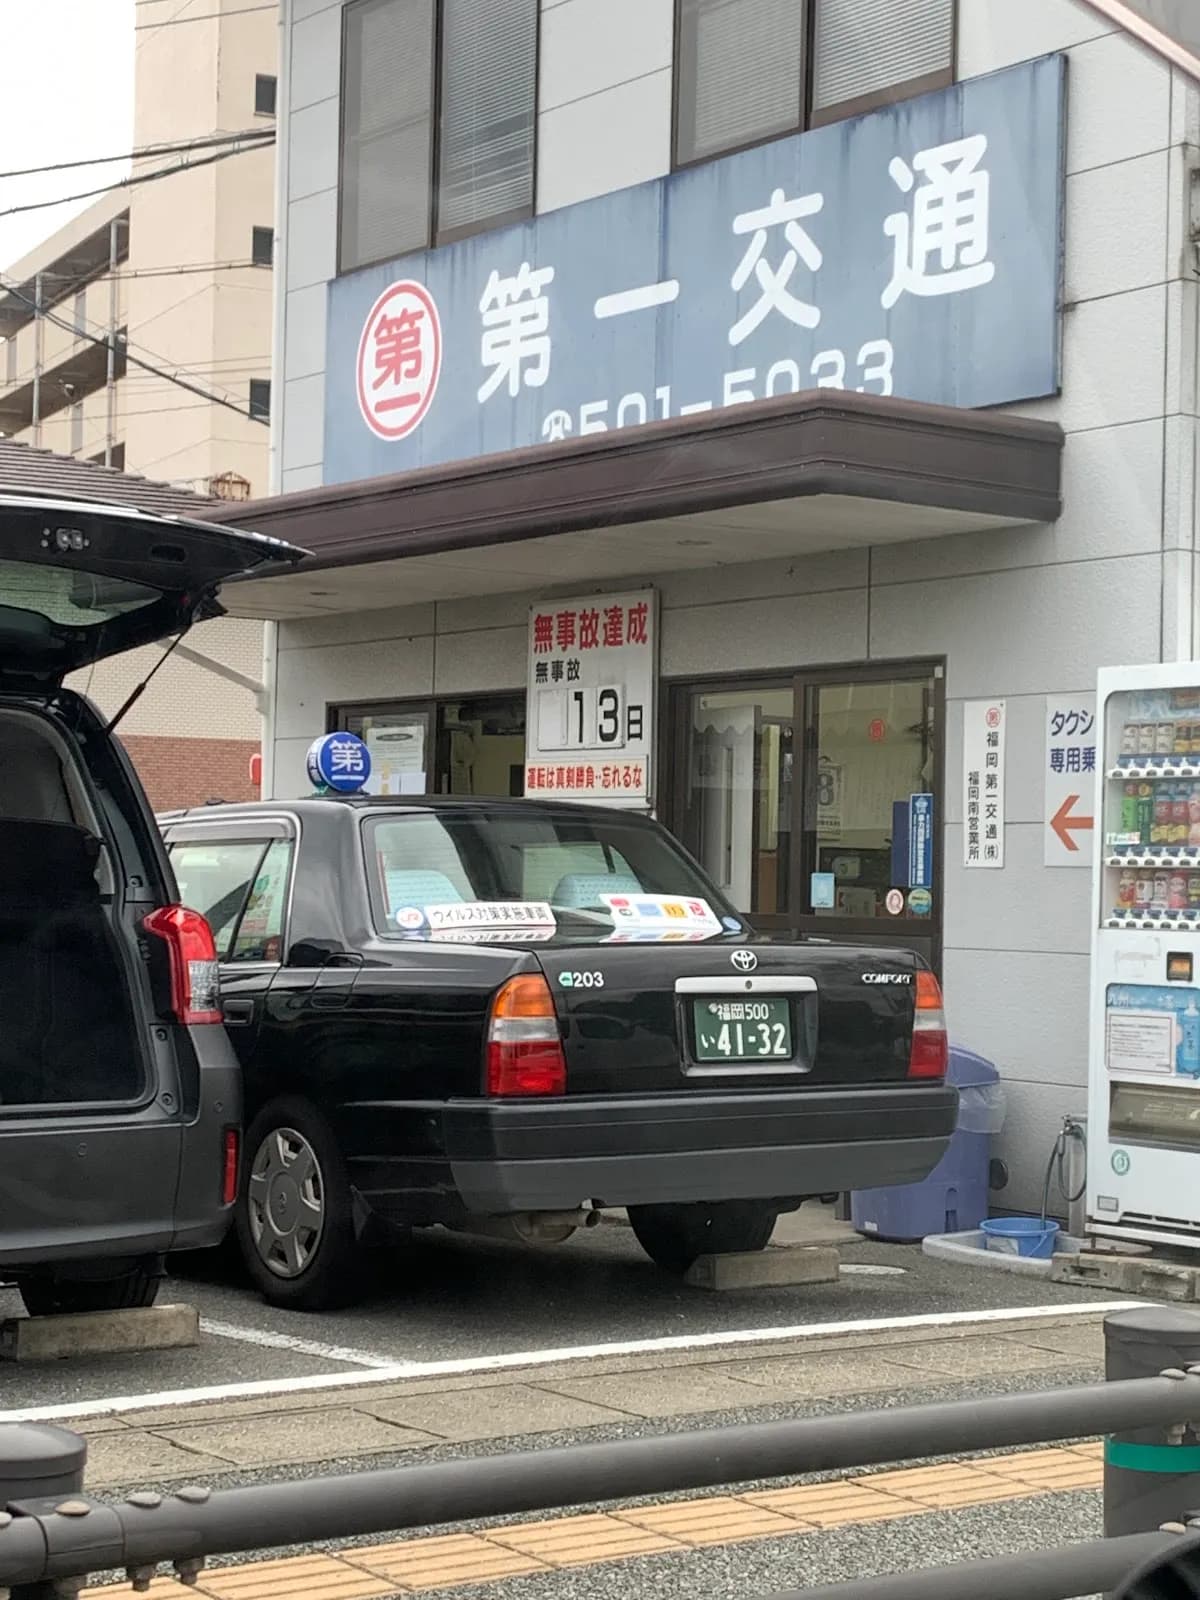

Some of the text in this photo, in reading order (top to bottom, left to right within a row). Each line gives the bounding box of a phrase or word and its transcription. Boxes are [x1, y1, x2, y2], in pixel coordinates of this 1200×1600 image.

[477, 133, 995, 403] 第一交通
[373, 307, 426, 416] 第一
[534, 602, 649, 654] 無事故達成
[535, 658, 580, 684] 無事故
[1051, 710, 1094, 736] タクシ
[328, 740, 365, 781] 第一
[1050, 746, 1096, 773] 専用乗
[968, 771, 979, 860] 福岡南営業所
[573, 971, 604, 987] 203
[862, 973, 912, 984] COMFORT
